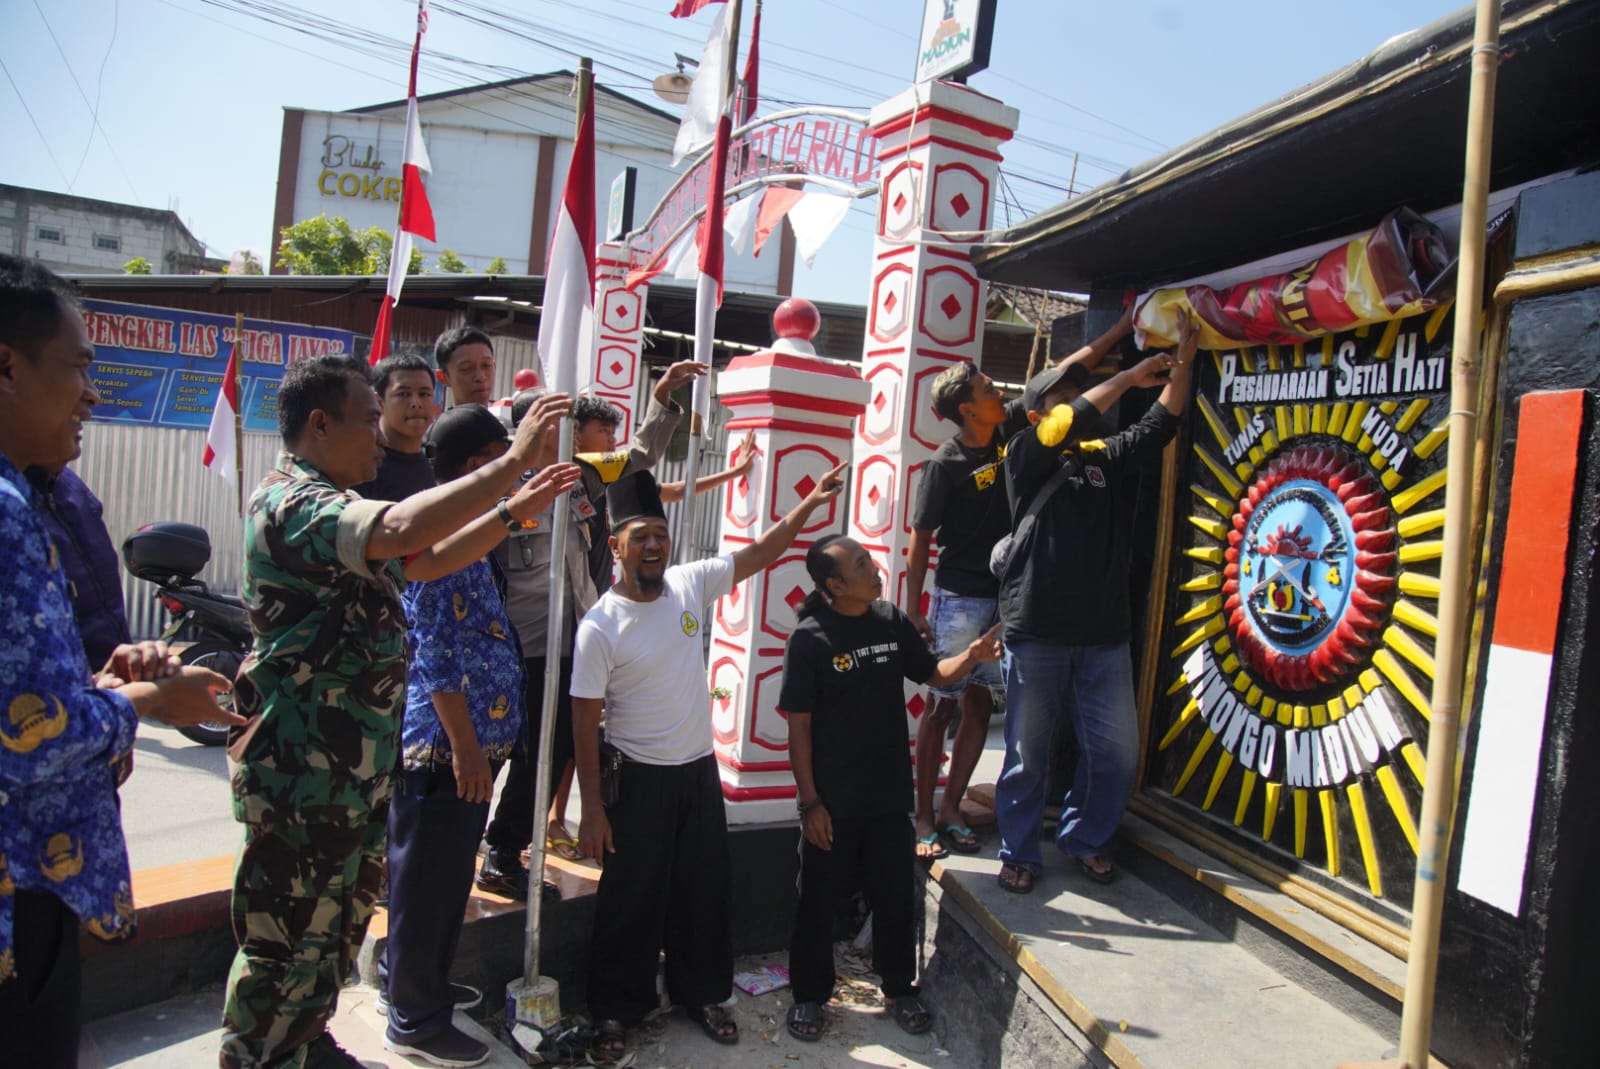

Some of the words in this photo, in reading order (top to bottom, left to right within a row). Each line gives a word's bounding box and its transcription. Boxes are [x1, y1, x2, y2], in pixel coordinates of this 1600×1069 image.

[920, 27, 970, 67] MADIUN
[318, 170, 401, 202] COKR
[81, 311, 175, 353] BENGKEL
[179, 322, 218, 358] LAS
[97, 365, 123, 375] SERVIS
[126, 367, 153, 377] SEPEDA
[1334, 340, 1387, 397] SETIA
[1392, 332, 1446, 393] HATI
[1223, 413, 1265, 466] TUNAS
[1360, 405, 1409, 472] MUDA
[1182, 639, 1276, 778] WINONGO
[1285, 685, 1404, 788] MADIUN
